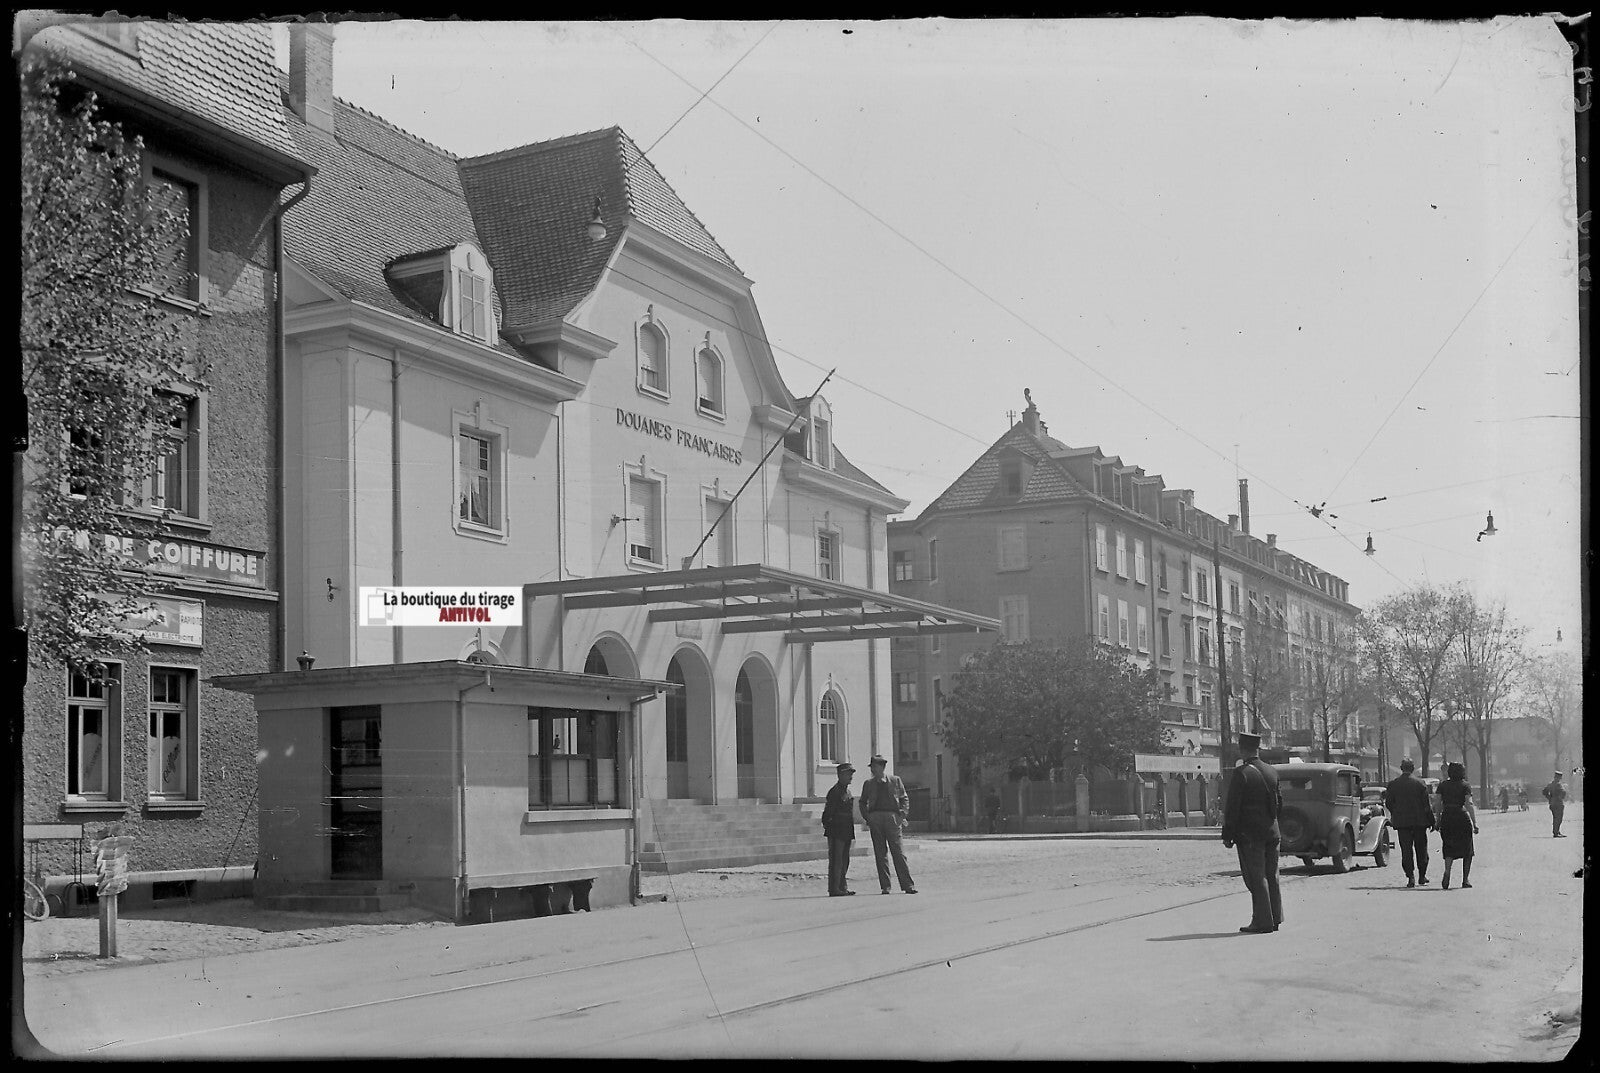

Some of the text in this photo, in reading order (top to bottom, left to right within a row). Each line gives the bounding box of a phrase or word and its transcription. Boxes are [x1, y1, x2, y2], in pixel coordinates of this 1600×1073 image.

[616, 407, 742, 466] DOUANES FRANÇAISES
[104, 534, 134, 556] DE
[147, 540, 257, 575] COIFFURE
